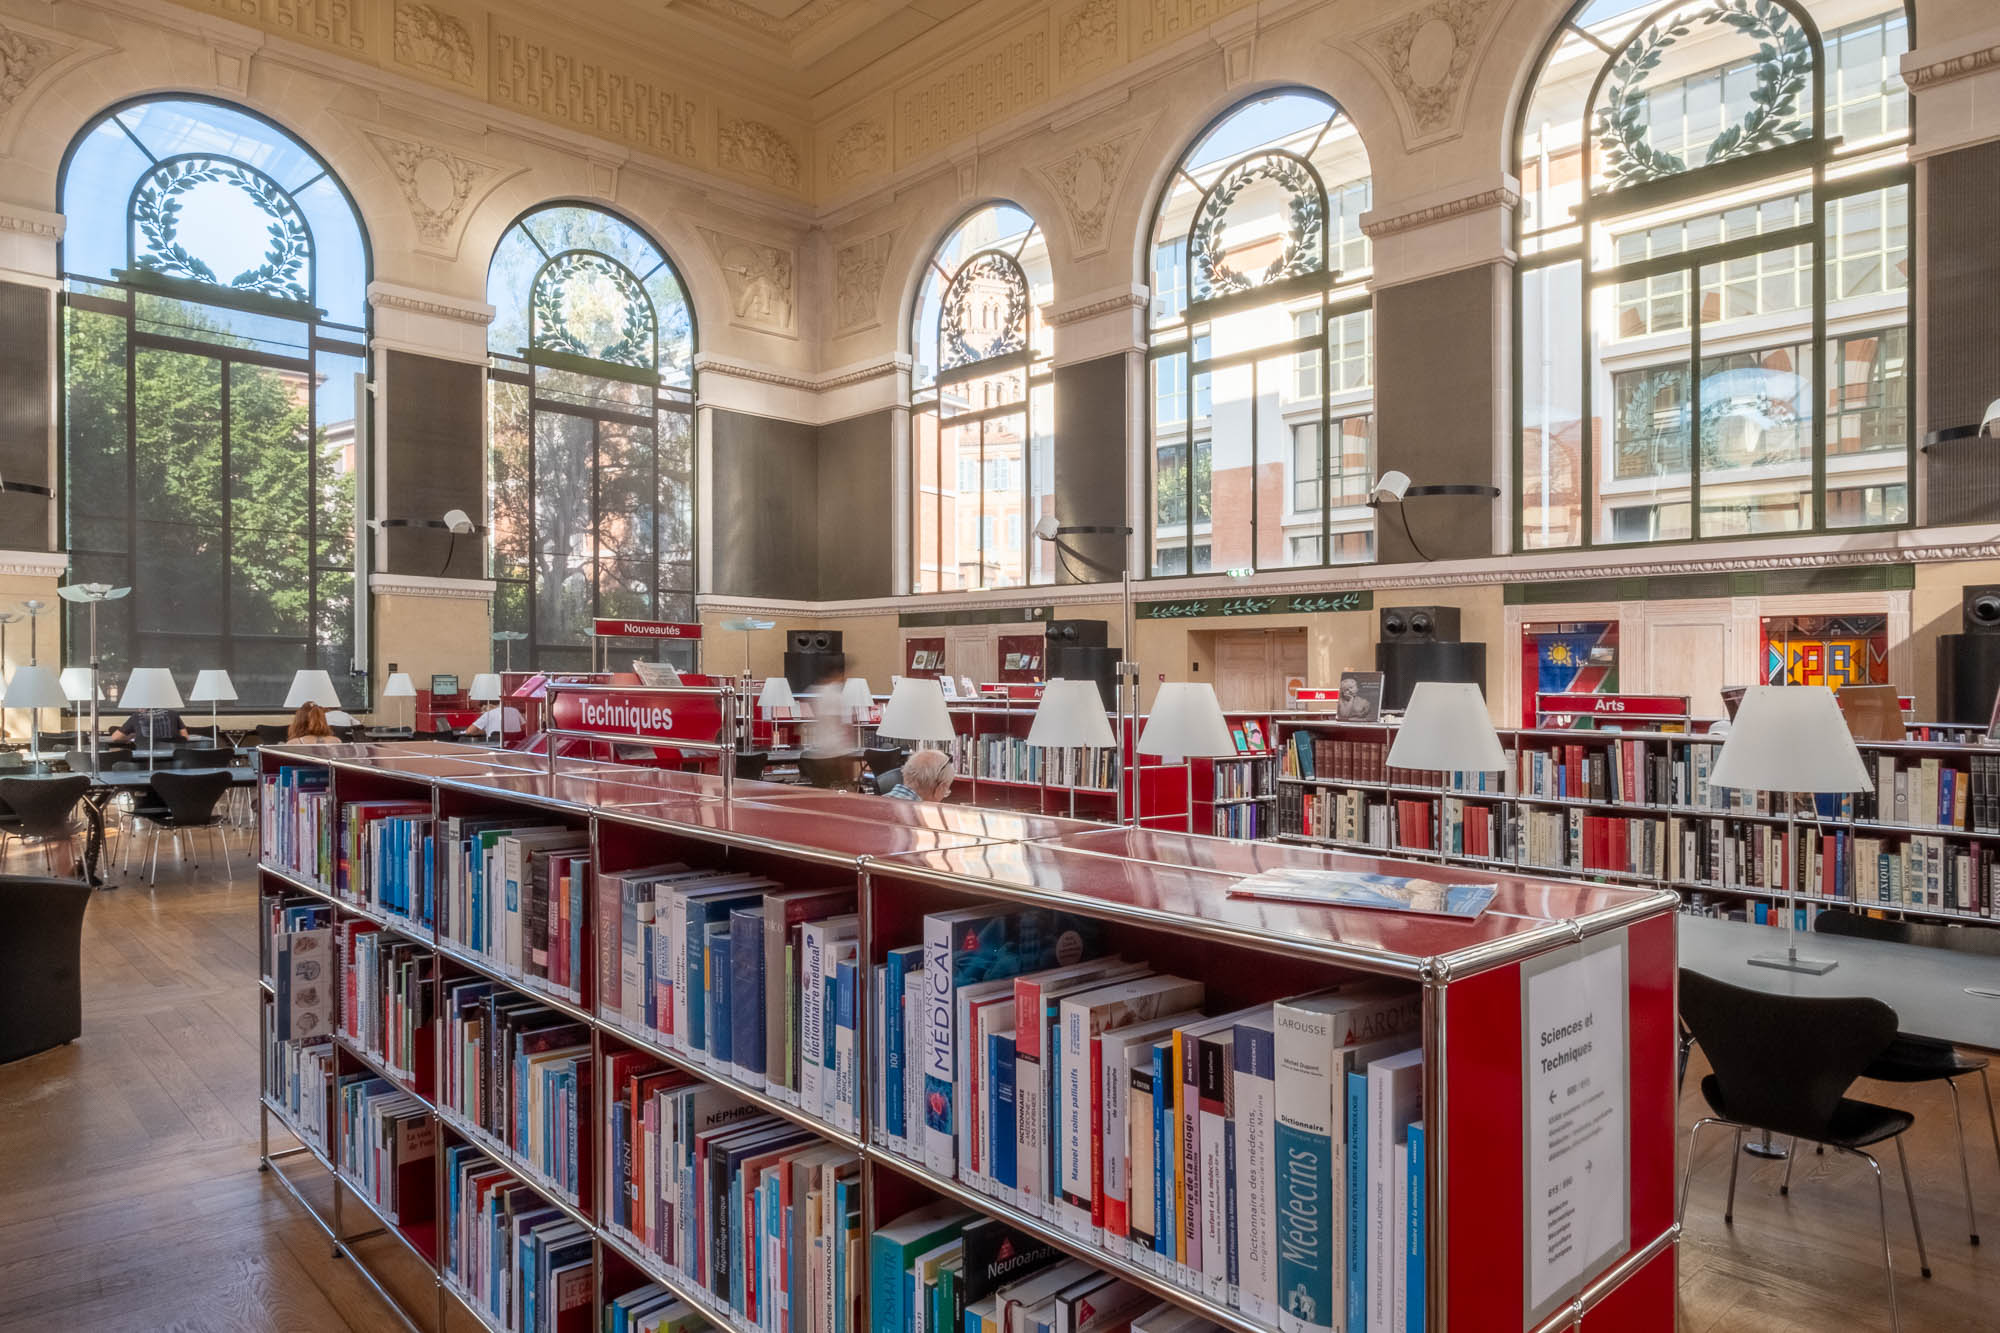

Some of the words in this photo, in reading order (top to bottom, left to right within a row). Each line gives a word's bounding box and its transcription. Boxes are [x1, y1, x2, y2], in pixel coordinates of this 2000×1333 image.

[624, 623, 681, 636] Nouveautés
[578, 697, 673, 735] Techniques
[1594, 699, 1625, 711] Arts
[1880, 858, 1889, 901] LEXIQUE
[600, 910, 609, 1000] LAROUSSE
[809, 944, 820, 989] médical
[924, 939, 933, 1029] LAROUSSE
[803, 993, 811, 1039] nouveau
[930, 935, 950, 1072] MÉDICAL
[1352, 1003, 1419, 1036] LAROU
[810, 990, 820, 1058] dictionnaire
[1278, 1017, 1327, 1036] LAROUSSE
[1541, 1019, 1583, 1047] Sciences
[1584, 1012, 1593, 1028] et
[889, 1052, 899, 1069] 100
[1540, 1041, 1593, 1074] Techniques
[1070, 1067, 1079, 1108] palliatifs
[705, 1104, 758, 1125] NÉPHROL
[1070, 1109, 1078, 1134] soins
[1112, 1109, 1117, 1119] de
[1281, 1114, 1324, 1132] Dictionnaire
[1070, 1135, 1078, 1147] de
[1184, 1114, 1193, 1161] biologie
[1247, 1109, 1257, 1166] médecins,
[1258, 1130, 1264, 1139] la
[1258, 1141, 1264, 1151] de
[623, 1140, 631, 1177] DENT
[1070, 1148, 1079, 1181] Manuel
[1185, 1163, 1193, 1174] la
[623, 1180, 631, 1196] LA
[1185, 1176, 1193, 1191] de
[1248, 1169, 1257, 1190] des
[1259, 1153, 1267, 1215] pharmaciens
[719, 1195, 727, 1226] clinique
[1186, 1194, 1194, 1240] Histoire
[1208, 1200, 1215, 1208] et
[1280, 1148, 1318, 1271] Médecins
[1375, 1182, 1383, 1219] MÉDECINE
[1208, 1209, 1216, 1239] L'enfant
[1249, 1193, 1259, 1262] Dictionnaire
[1259, 1217, 1266, 1228] et
[719, 1226, 728, 1275] Néphrologie
[987, 1244, 1059, 1281] Neuroanat
[1260, 1231, 1268, 1283] chirurgiens
